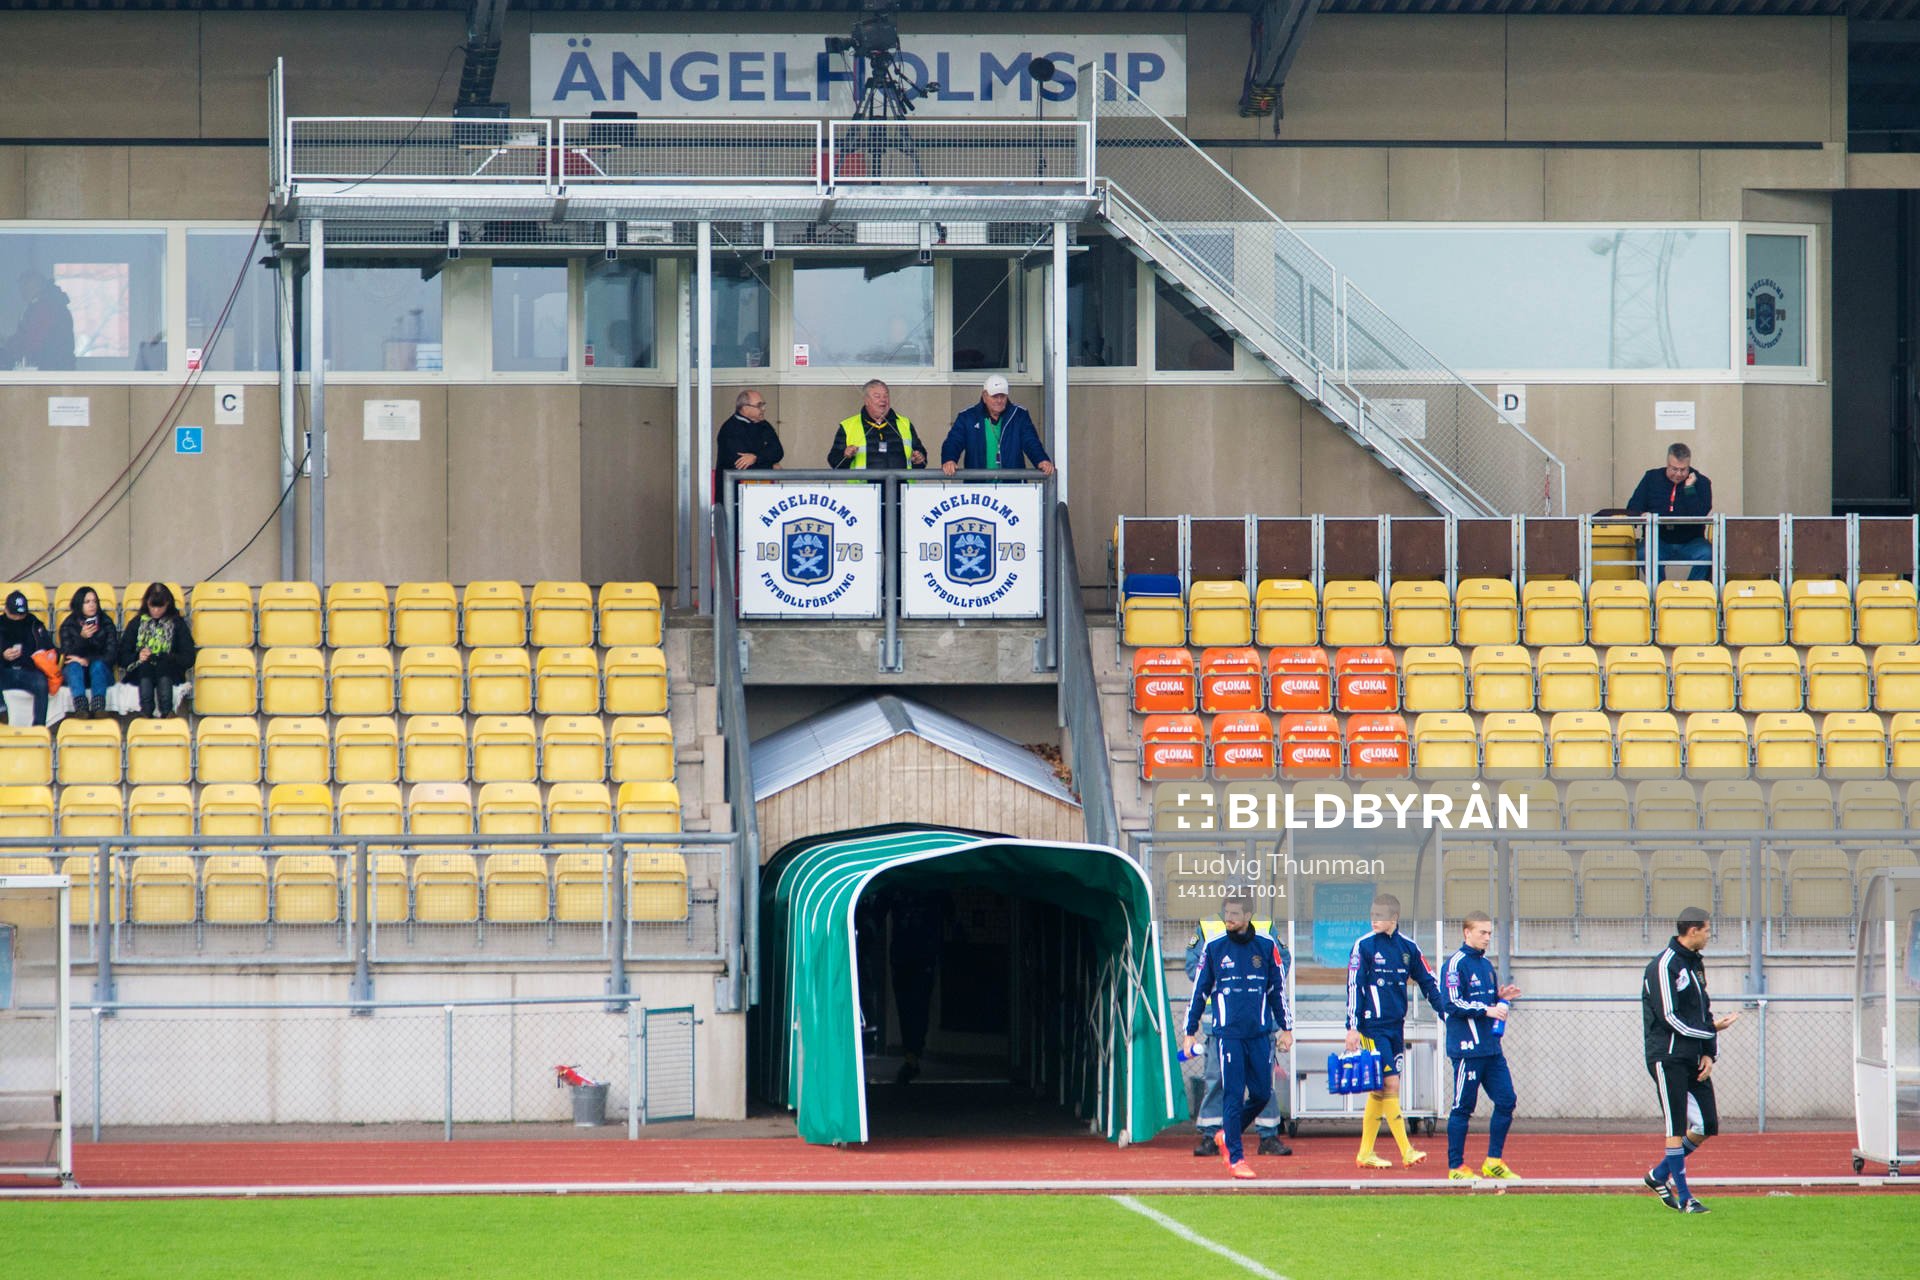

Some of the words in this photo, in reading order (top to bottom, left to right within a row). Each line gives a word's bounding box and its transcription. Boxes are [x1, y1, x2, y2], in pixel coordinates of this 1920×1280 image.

[552, 38, 1077, 102] ÄNGELHOLMS
[1103, 51, 1165, 102] IP
[222, 394, 237, 412] C
[1504, 394, 1519, 411] D
[760, 494, 858, 528] ÄNGELHOLMS
[921, 493, 1020, 528] ÄNGELHOLMS
[757, 542, 781, 561] 19
[836, 543, 863, 562] 76
[919, 542, 943, 561] 19
[998, 542, 1026, 561] 76
[761, 572, 856, 608] FOTBOLLFÖRENING
[923, 572, 1018, 608] FOTBOLLFÖRENING
[1155, 681, 1184, 691] LOKAL
[1223, 680, 1251, 690] LOKAL
[1291, 680, 1320, 690] LOKAL
[1359, 680, 1387, 690] LOKAL
[1165, 749, 1194, 759] LOKAL
[1234, 748, 1263, 758] LOKAL
[1302, 748, 1331, 758] LOKAL
[1370, 748, 1399, 758] LOKAL
[1460, 1041, 1474, 1051] 24
[1468, 1071, 1477, 1081] 24
